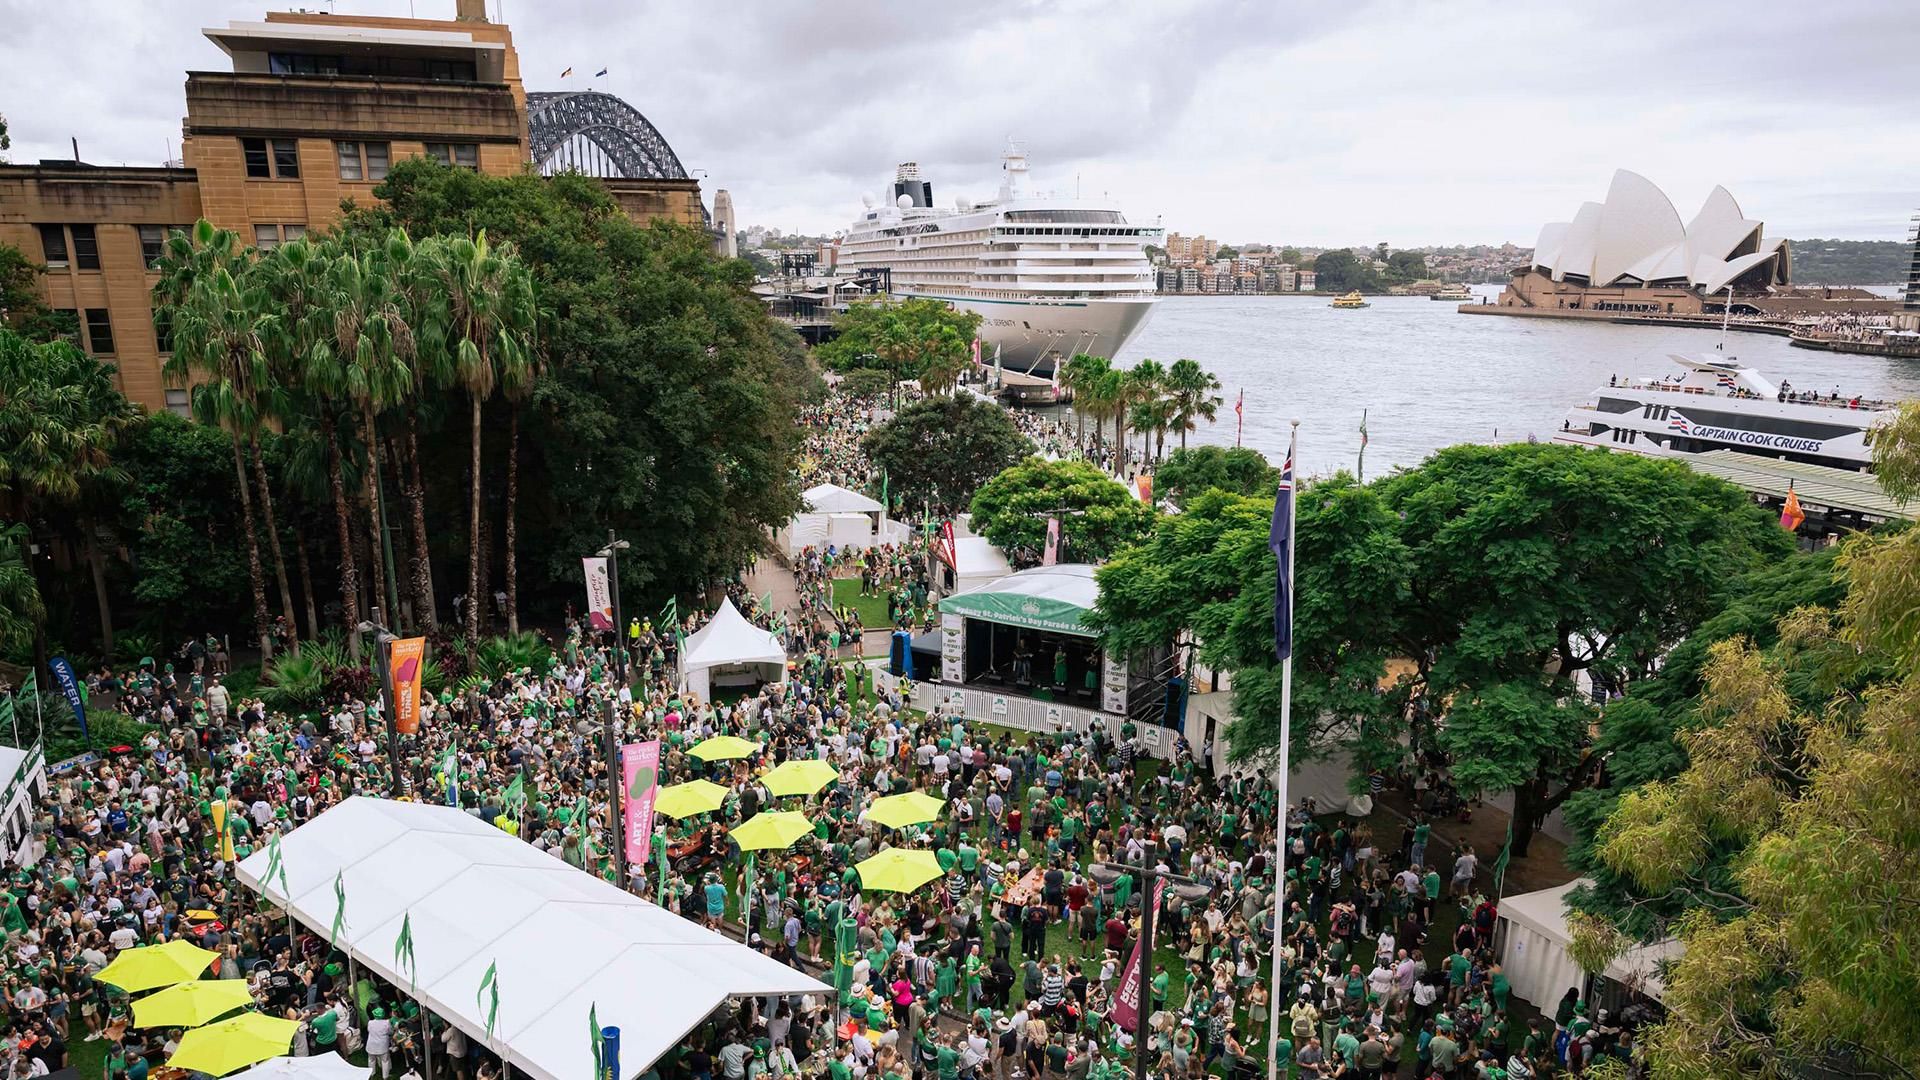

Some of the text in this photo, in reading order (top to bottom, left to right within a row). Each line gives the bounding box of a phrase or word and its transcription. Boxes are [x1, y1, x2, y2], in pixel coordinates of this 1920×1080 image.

[994, 318, 1016, 327] SERENITY
[1692, 426, 1823, 452] CAPTAIN COOK CRUISES
[993, 611, 1028, 624] Patrick's
[1028, 617, 1043, 627] Day
[1043, 619, 1070, 630] Parade
[55, 661, 80, 706] WATER
[632, 810, 642, 846] ART &
